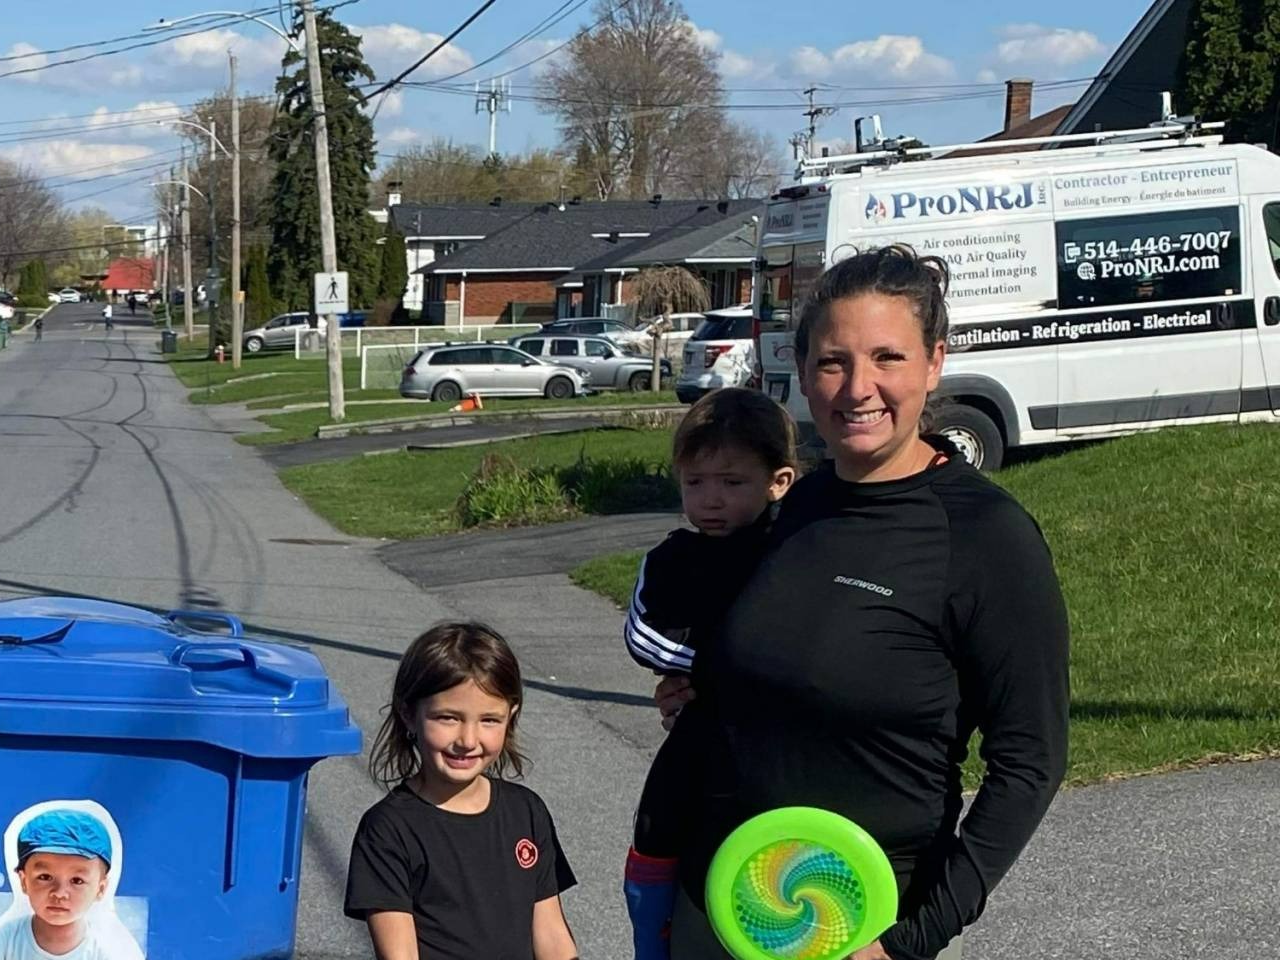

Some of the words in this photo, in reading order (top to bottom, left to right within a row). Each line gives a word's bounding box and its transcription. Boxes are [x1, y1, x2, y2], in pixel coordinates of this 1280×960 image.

[1055, 173, 1128, 189] Contractor
[1140, 165, 1233, 183] Entrepreneur
[891, 181, 1034, 219] ProNRJ
[1064, 196, 1101, 208] Building
[1101, 194, 1132, 205] Energy
[1174, 189, 1185, 198] du
[1186, 186, 1226, 197] batiment
[923, 238, 941, 249] Air
[942, 231, 1022, 249] conditionning
[1084, 230, 1231, 260] 514-446-7007
[966, 250, 984, 263] Air
[985, 246, 1027, 262] Quality
[948, 265, 990, 281] hermal
[991, 264, 1038, 279] imaging
[1100, 254, 1220, 278] ProNRJ.com
[947, 284, 1022, 299] trumentation
[949, 326, 1020, 347] entilation
[1032, 317, 1131, 341] Refrigeration
[1143, 310, 1211, 330] Electrical
[833, 575, 894, 597] SHERWOOD
